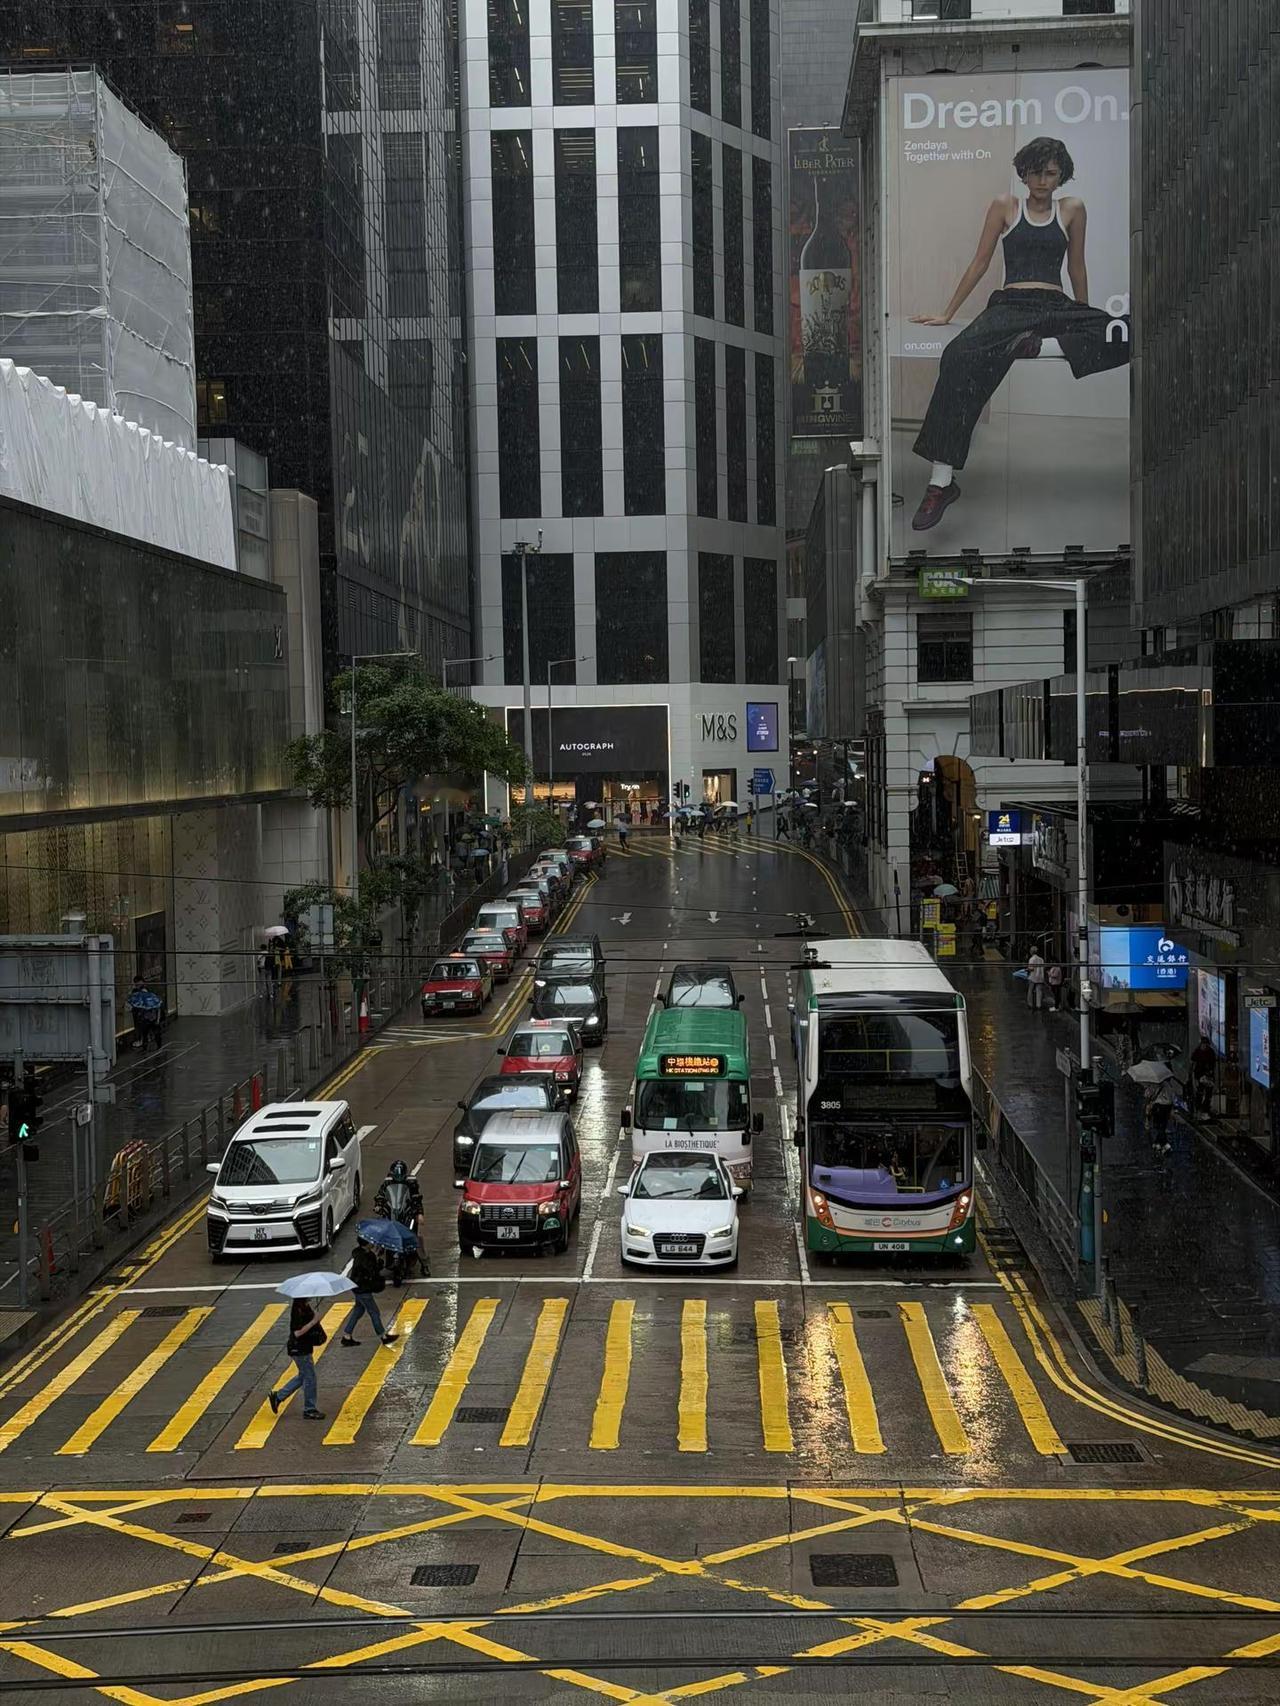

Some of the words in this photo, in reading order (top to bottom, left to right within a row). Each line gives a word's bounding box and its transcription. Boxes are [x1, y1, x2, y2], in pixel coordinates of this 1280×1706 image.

[903, 92, 1042, 130] Dream
[903, 140, 948, 151] Zendaya
[904, 151, 949, 164] Together
[951, 149, 974, 160] with
[975, 148, 992, 159] On
[904, 341, 942, 351] on.com
[702, 714, 737, 742] M&S
[559, 743, 614, 751] AUTOGRAPH
[820, 1101, 841, 1110] 3805
[665, 1140, 673, 1148] LA
